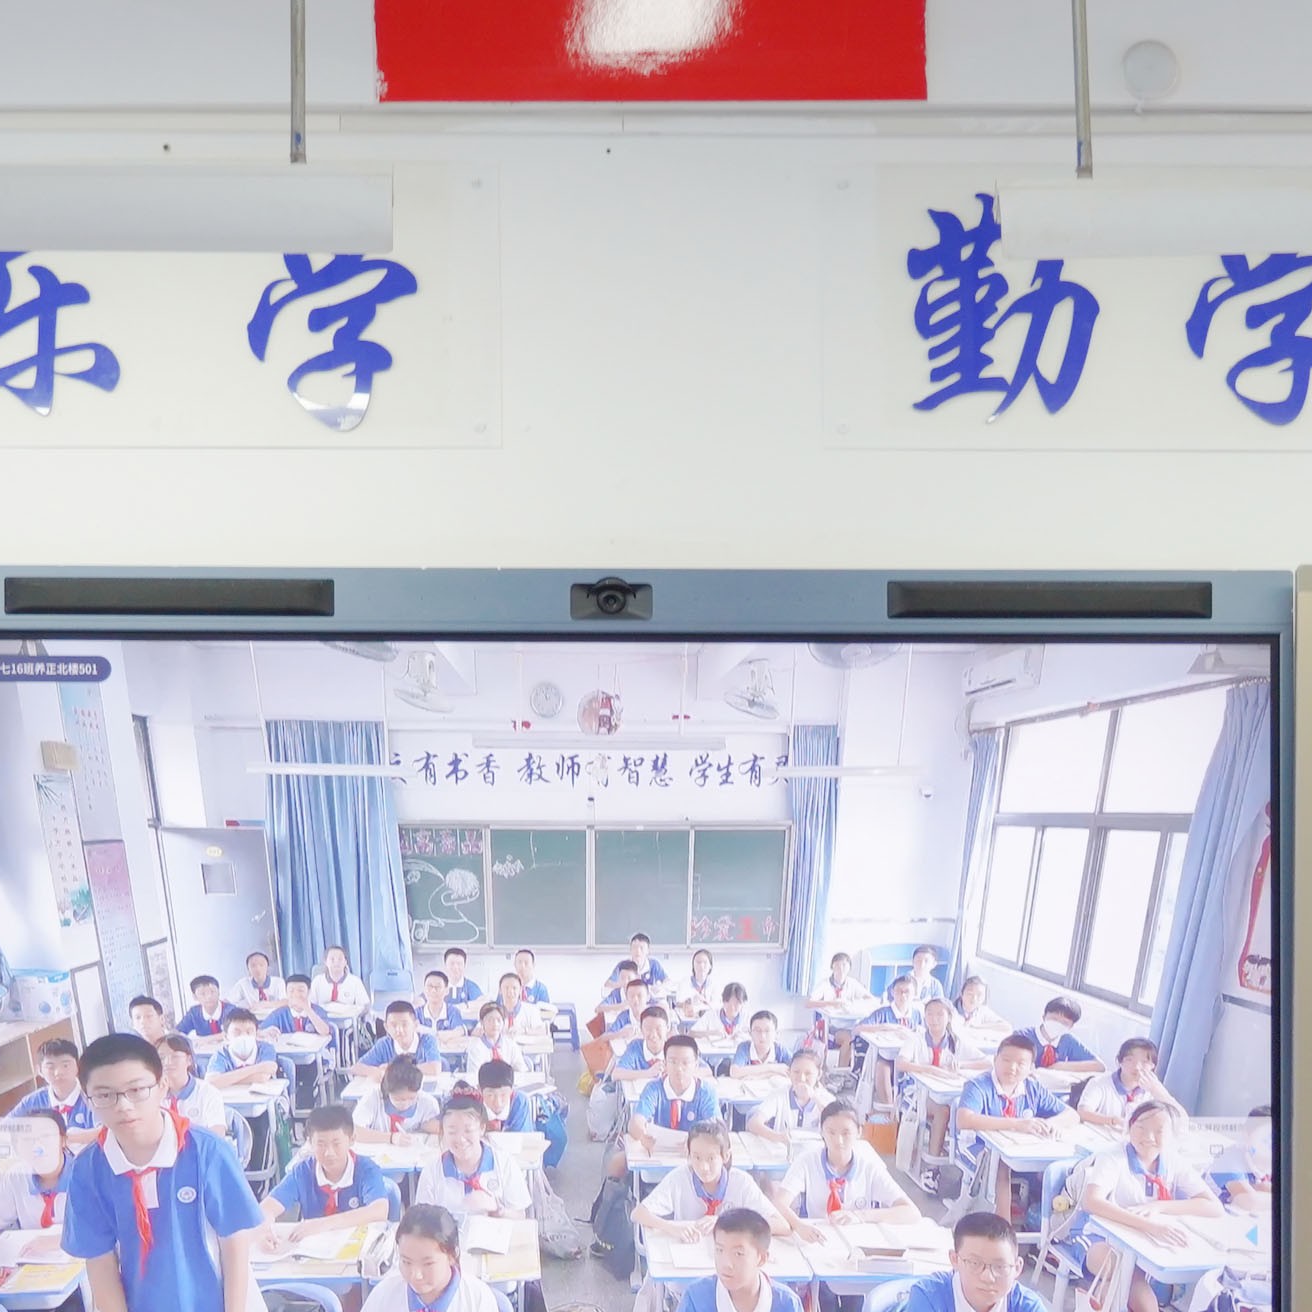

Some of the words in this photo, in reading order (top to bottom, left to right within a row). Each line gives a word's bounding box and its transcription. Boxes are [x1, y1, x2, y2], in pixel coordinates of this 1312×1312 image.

[0, 661, 98, 676] 七16班养正北楼501
